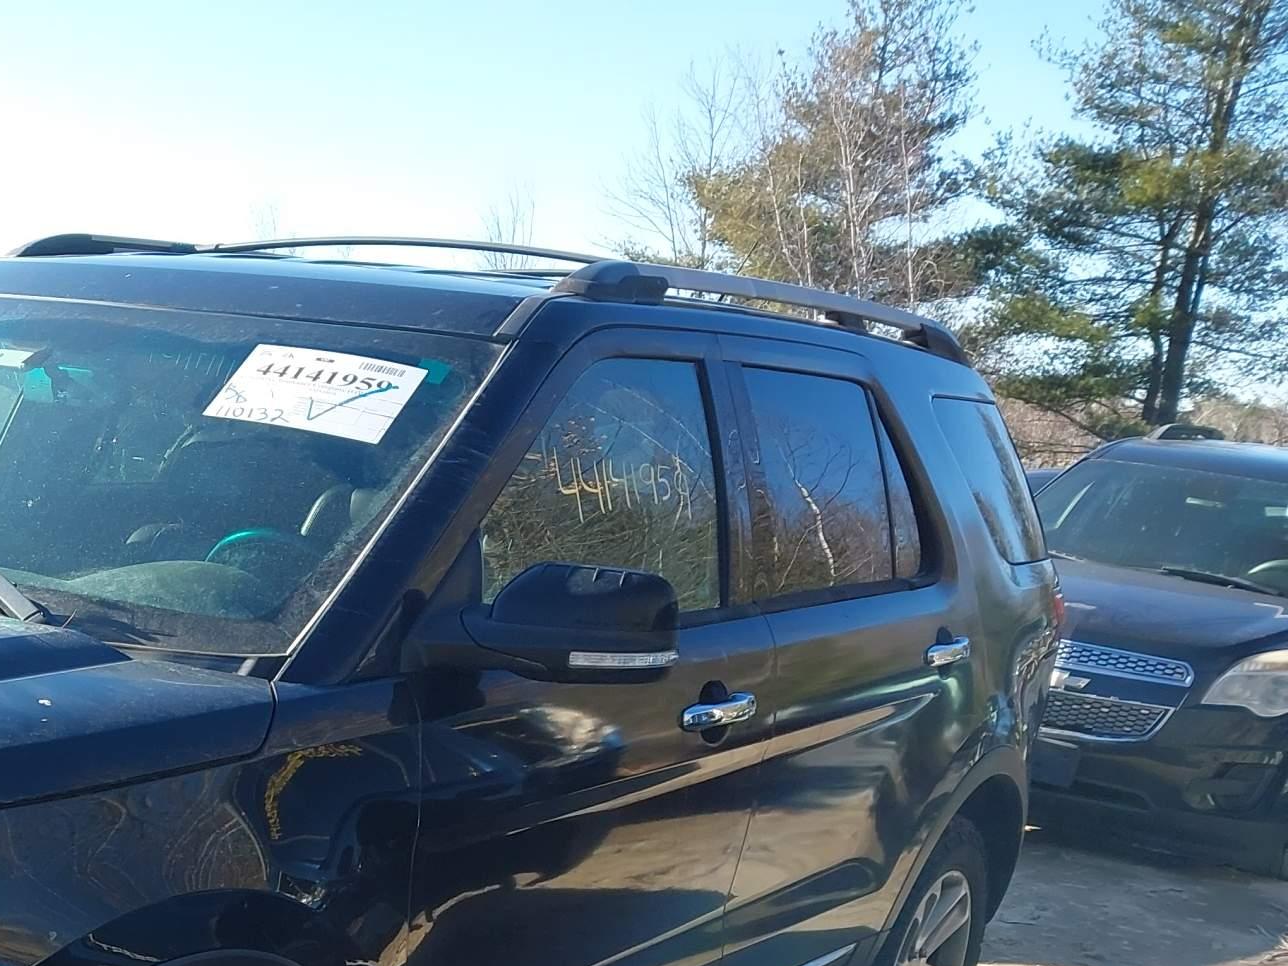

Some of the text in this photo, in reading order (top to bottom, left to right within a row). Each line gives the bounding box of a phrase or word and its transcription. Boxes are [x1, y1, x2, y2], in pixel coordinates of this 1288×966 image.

[256, 362, 394, 391] 44141959
[215, 405, 290, 424] 110132
[553, 447, 693, 524] 44141959
